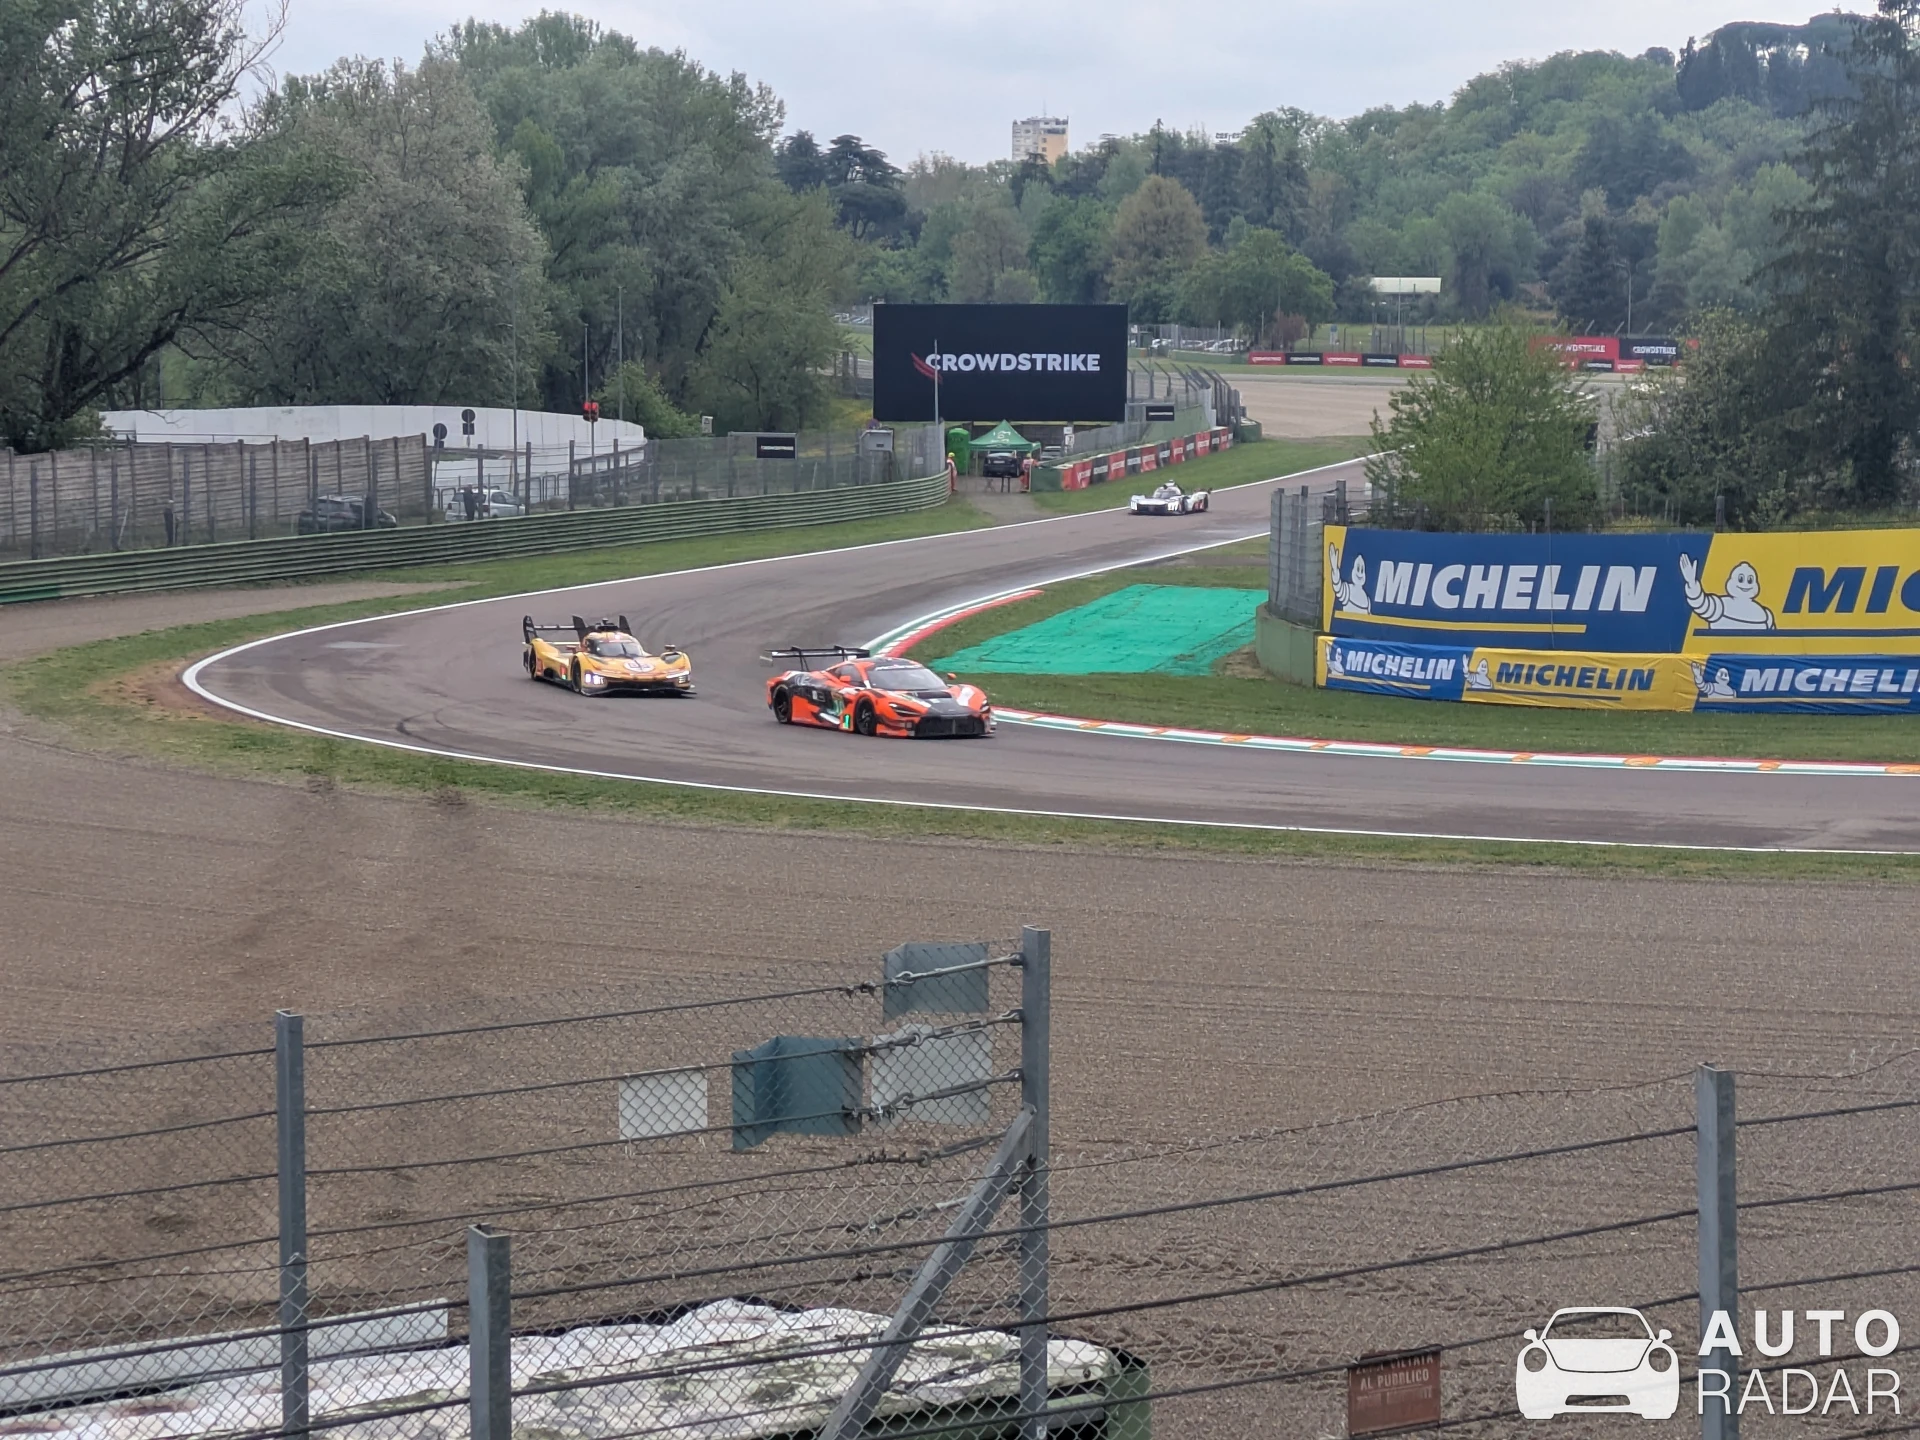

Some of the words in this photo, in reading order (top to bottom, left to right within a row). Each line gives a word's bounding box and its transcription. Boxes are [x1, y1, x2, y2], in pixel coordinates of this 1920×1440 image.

[925, 353, 1100, 372] CROWDSTRIKE
[1374, 560, 1657, 612] MICHELIN
[1345, 650, 1456, 681] MICHELIN
[1495, 662, 1655, 691] MICHELIN
[1740, 668, 1920, 693] MICHELI
[1360, 1377, 1373, 1391] AL
